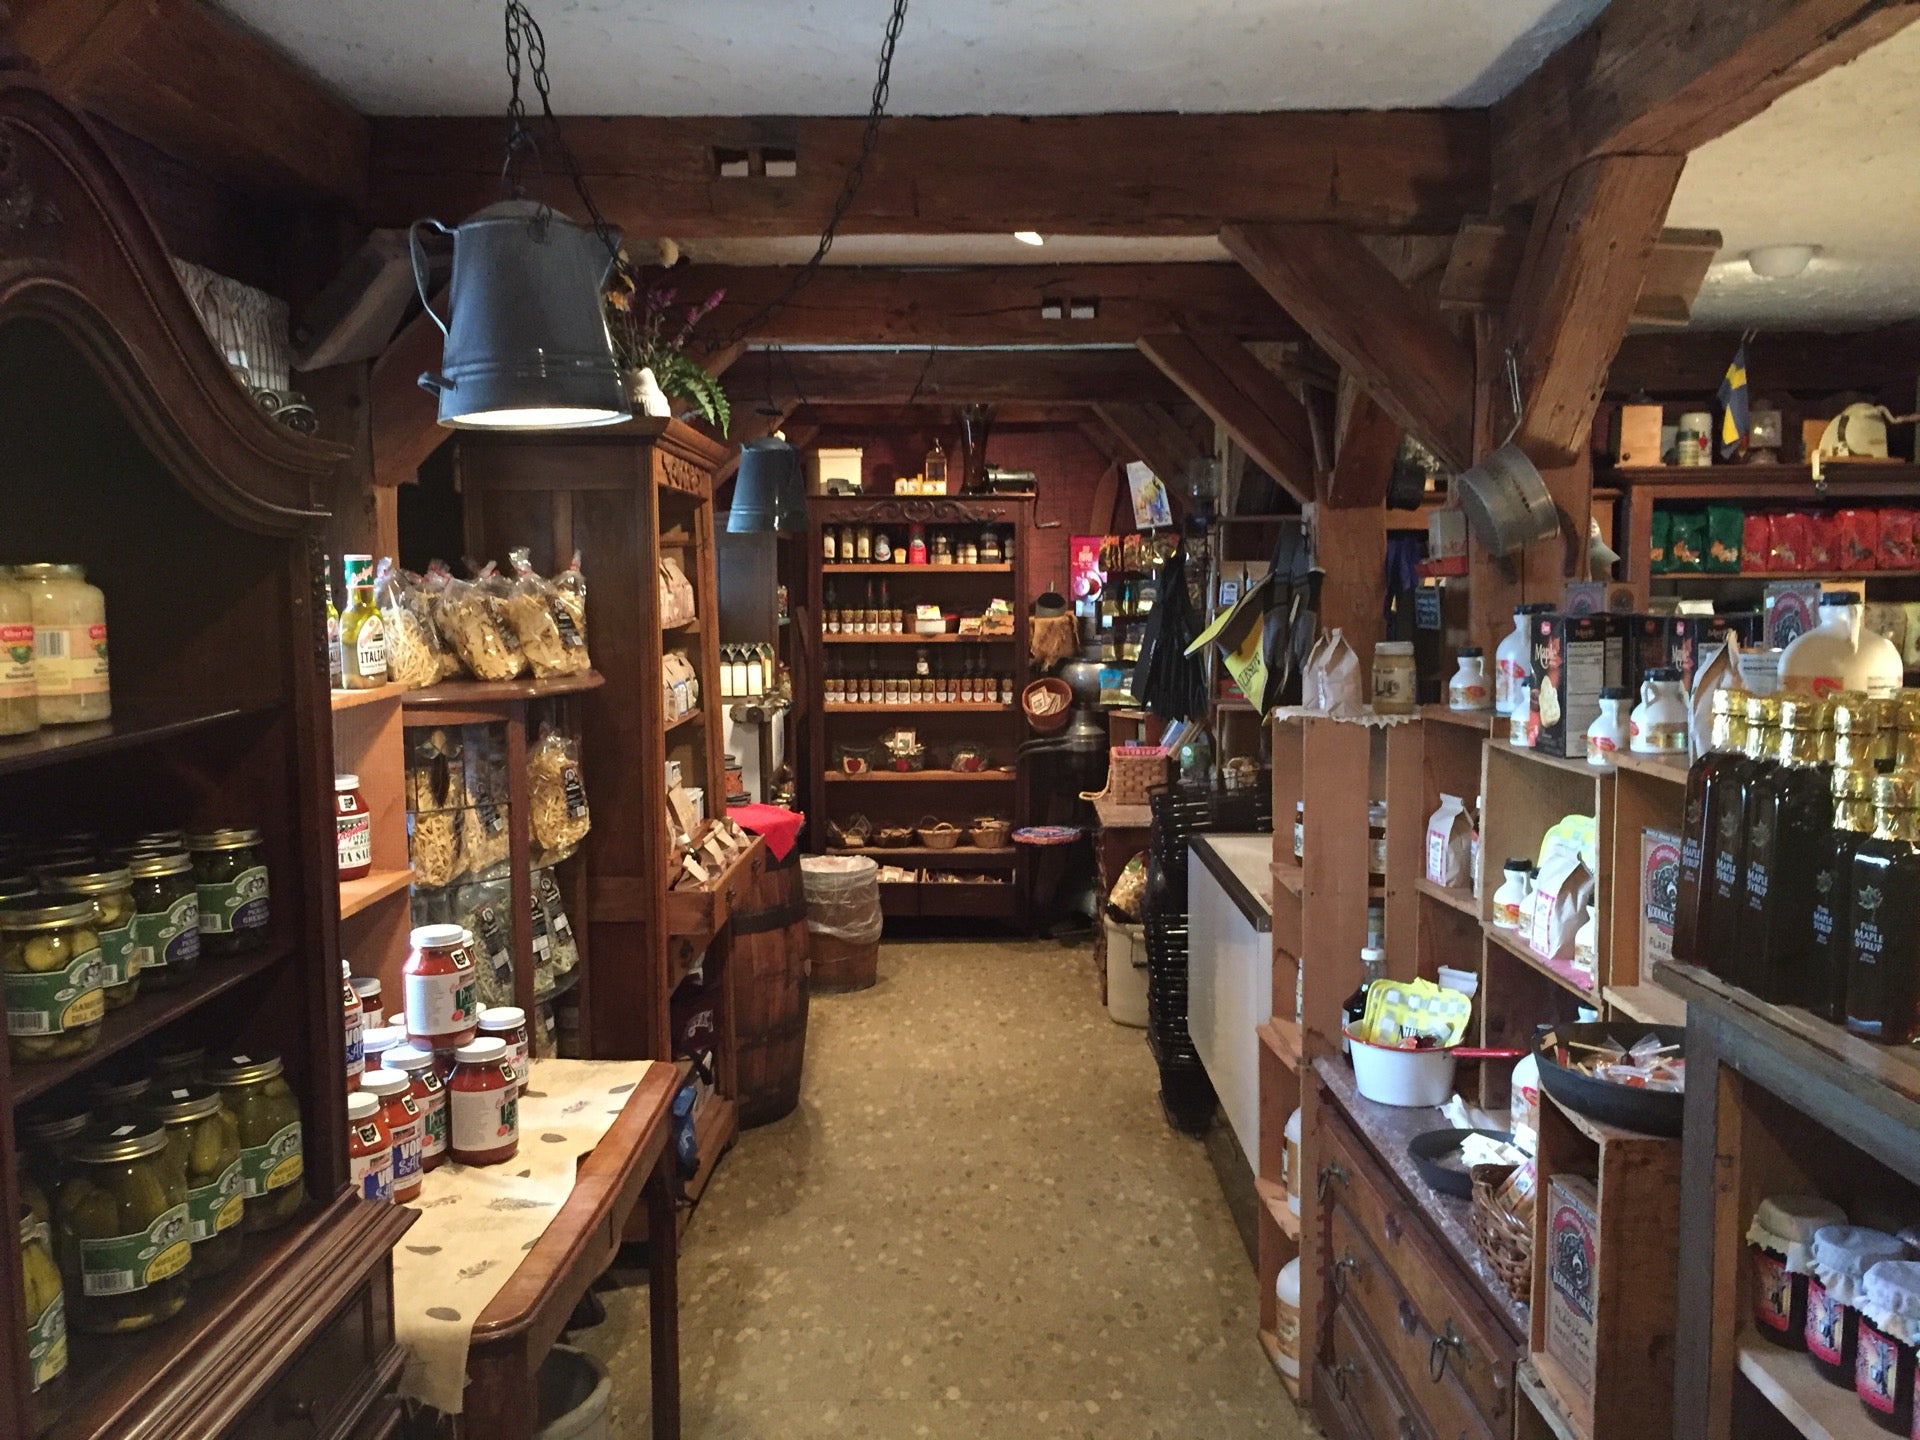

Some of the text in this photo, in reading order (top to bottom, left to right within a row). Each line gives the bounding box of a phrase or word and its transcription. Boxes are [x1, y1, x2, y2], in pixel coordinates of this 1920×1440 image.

[1716, 858, 1737, 876] MAPLE
[1747, 868, 1769, 887] MAPLE
[1813, 911, 1833, 926] MAPLE
[1854, 928, 1884, 944] MAPLE
[1650, 936, 1672, 954] FLAPJ
[1855, 938, 1883, 953] SYRUP
